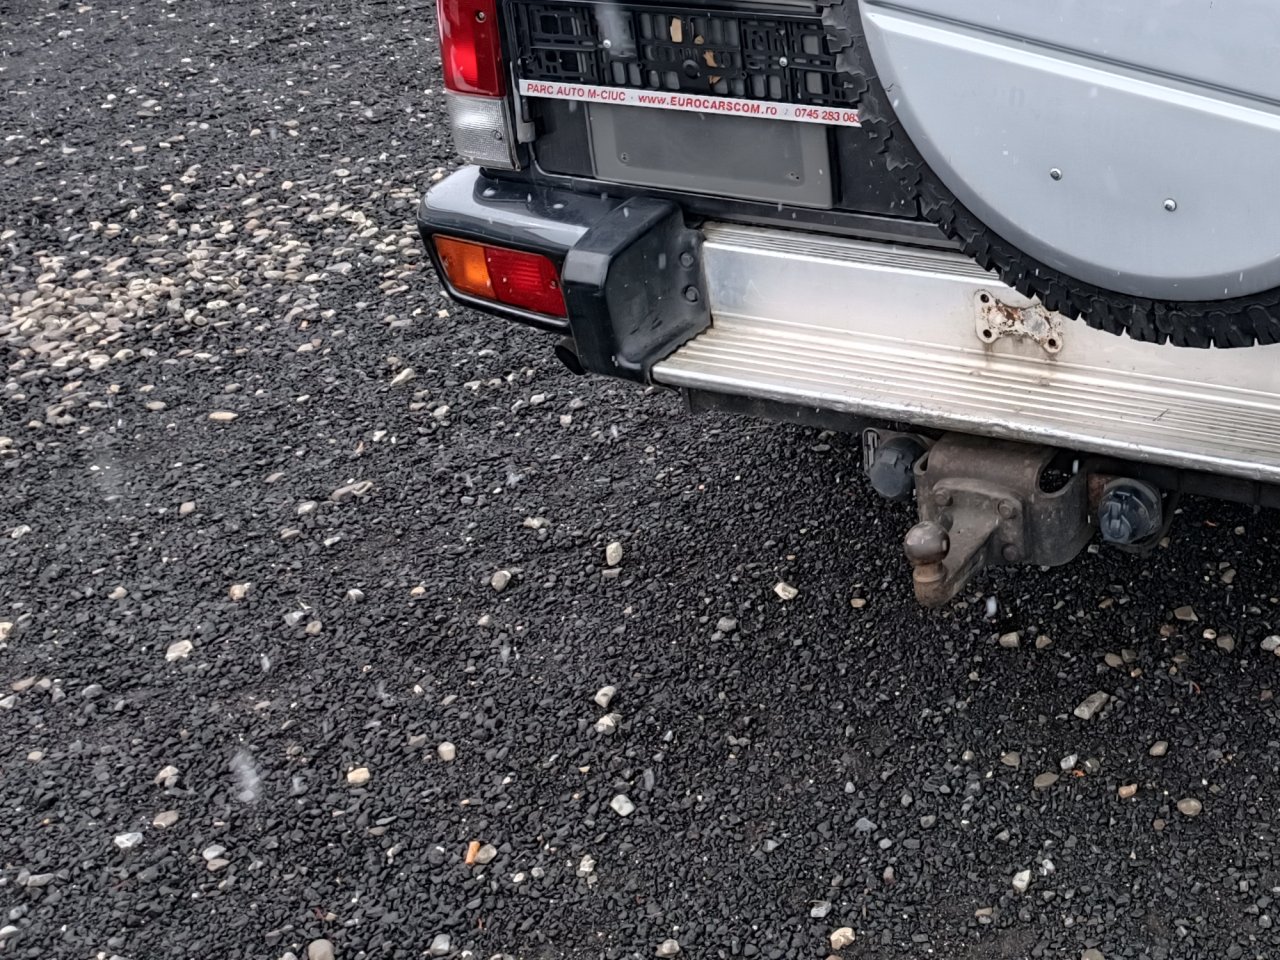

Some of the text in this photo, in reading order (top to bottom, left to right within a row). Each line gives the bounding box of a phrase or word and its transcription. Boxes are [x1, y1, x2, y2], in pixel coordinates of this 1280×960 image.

[527, 83, 554, 95] PARC
[556, 85, 584, 98] AUTO
[587, 90, 626, 102] M-CIUC
[638, 94, 777, 116] www.EUROCARSCOM.ro
[794, 108, 819, 120] 0745
